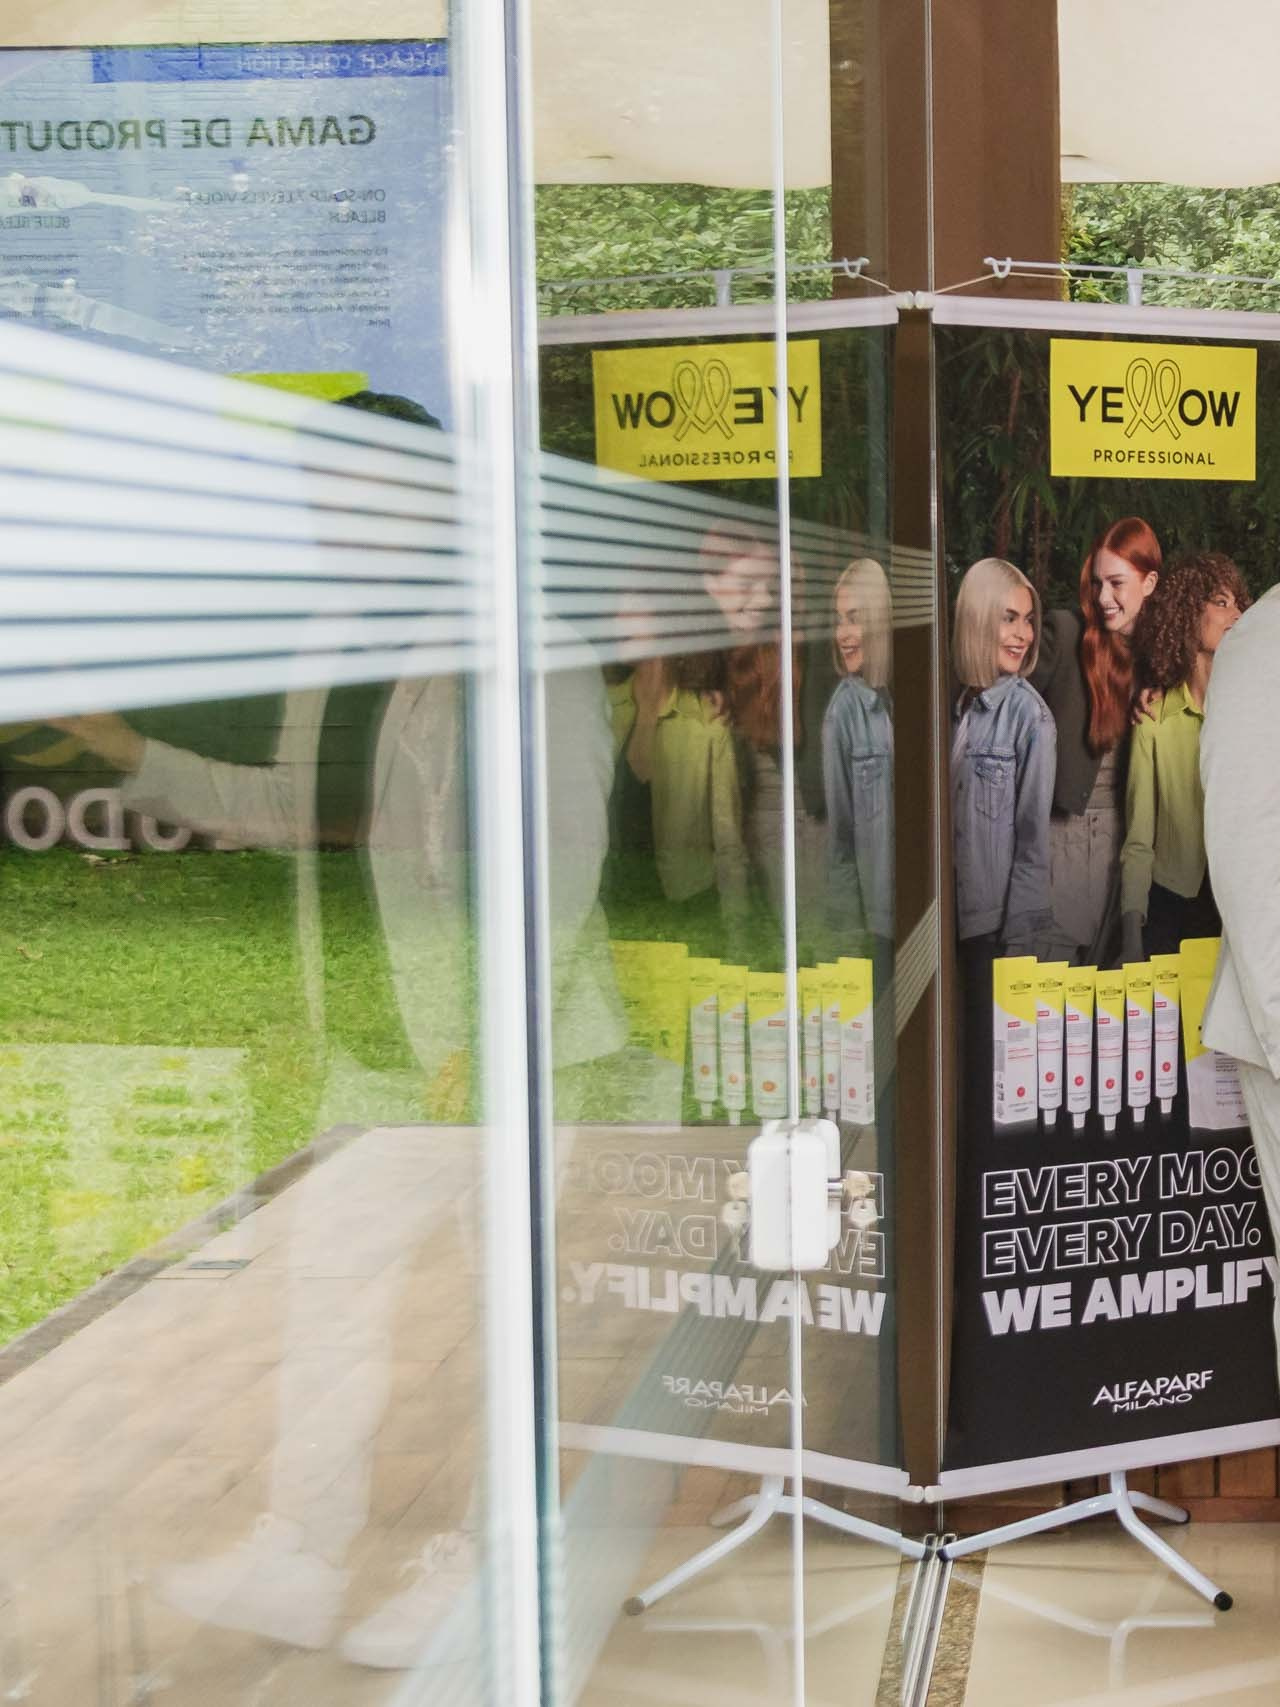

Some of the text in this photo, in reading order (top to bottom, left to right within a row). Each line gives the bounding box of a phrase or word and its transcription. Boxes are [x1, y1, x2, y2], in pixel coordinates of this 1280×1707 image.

[1068, 358, 1240, 440] YELLOW
[1094, 449, 1215, 465] PROFESSIONAL
[983, 1144, 1263, 1218] EVERY MOO
[983, 1201, 1261, 1277] EVERY DAY.
[982, 1282, 1072, 1336] WE
[1093, 1370, 1213, 1405] ALFAPARF
[1114, 1392, 1192, 1413] MILANO
